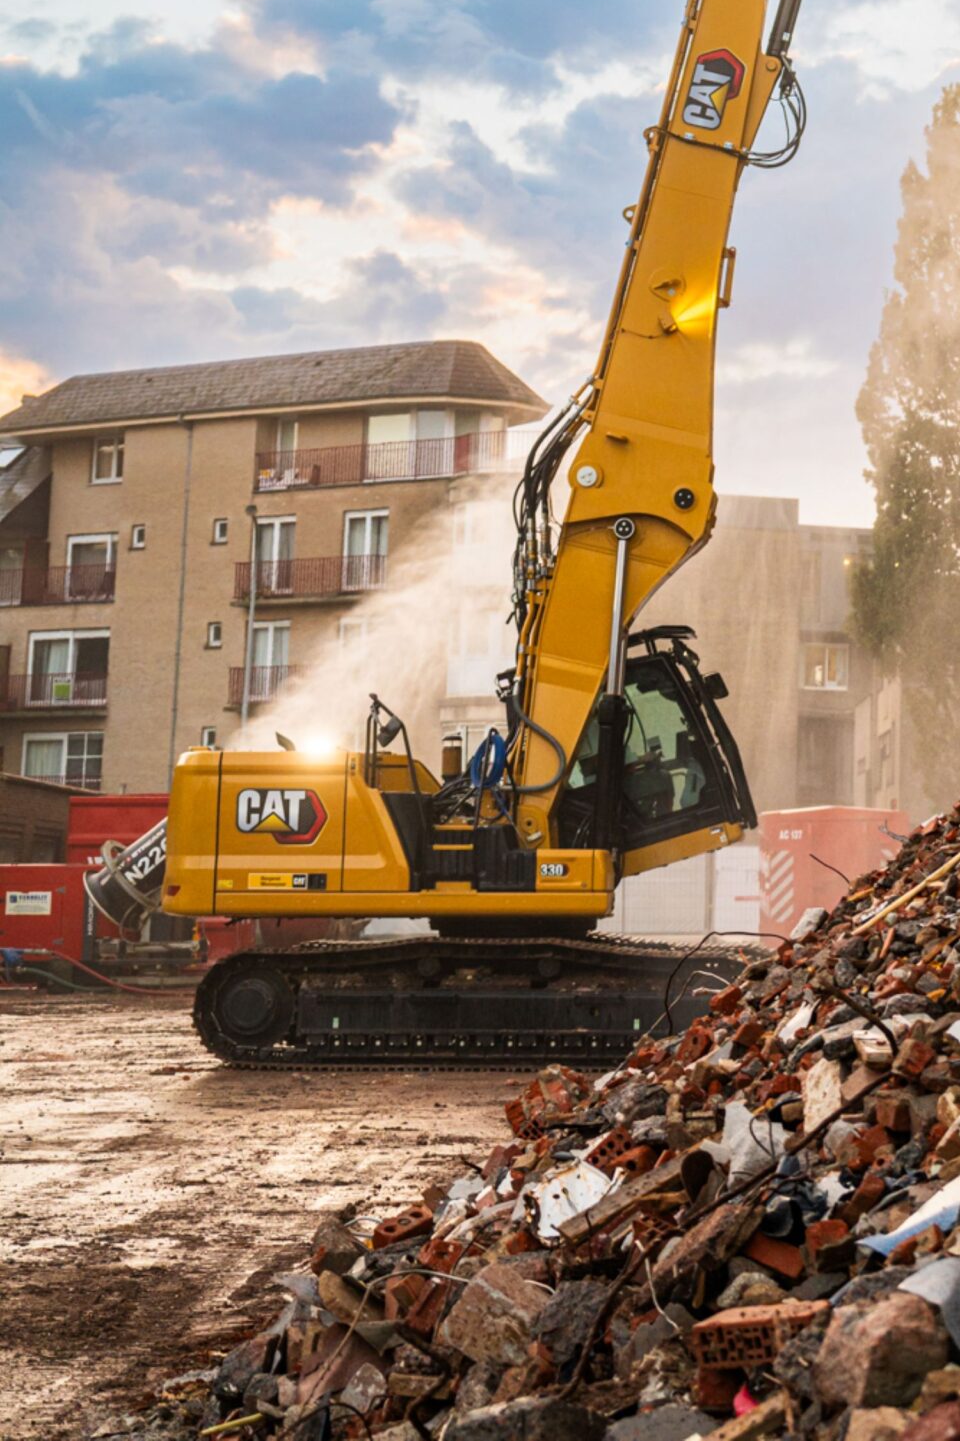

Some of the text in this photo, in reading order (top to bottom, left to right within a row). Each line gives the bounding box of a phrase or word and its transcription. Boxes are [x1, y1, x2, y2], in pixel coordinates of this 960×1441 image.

[683, 63, 731, 129] CAT
[238, 789, 306, 832] CAT
[540, 863, 564, 878] 330
